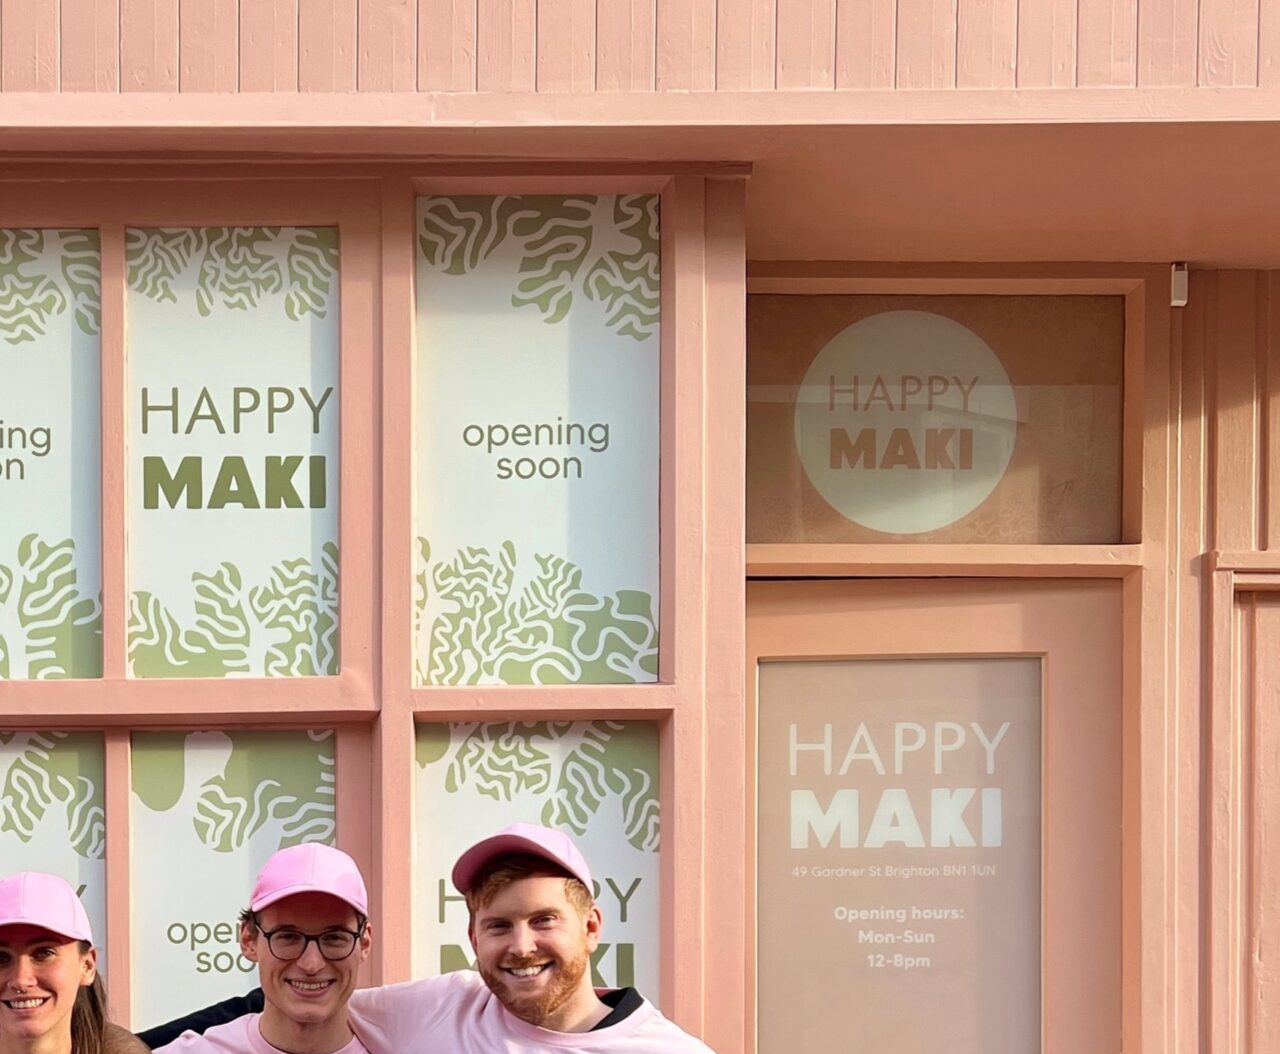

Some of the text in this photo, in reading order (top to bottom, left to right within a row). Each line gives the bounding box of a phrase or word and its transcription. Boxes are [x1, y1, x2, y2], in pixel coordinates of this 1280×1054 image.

[141, 385, 334, 435] HAPPY
[829, 375, 980, 412] HAPPY
[462, 416, 610, 454] opening
[829, 428, 974, 470] MAKI
[143, 455, 327, 510] MAKI
[496, 456, 583, 480] soon
[789, 721, 1011, 777] HAPPY
[790, 788, 1002, 849] MAKI
[791, 866, 808, 878] 49
[811, 866, 865, 878] Gardner
[869, 866, 882, 878] St
[885, 865, 940, 879] Brighton
[943, 865, 968, 877] BN1
[833, 906, 965, 923] Opening hours:
[858, 930, 936, 944] Mon-Sun
[195, 951, 257, 973] soo
[866, 954, 932, 970] 12-8pm
